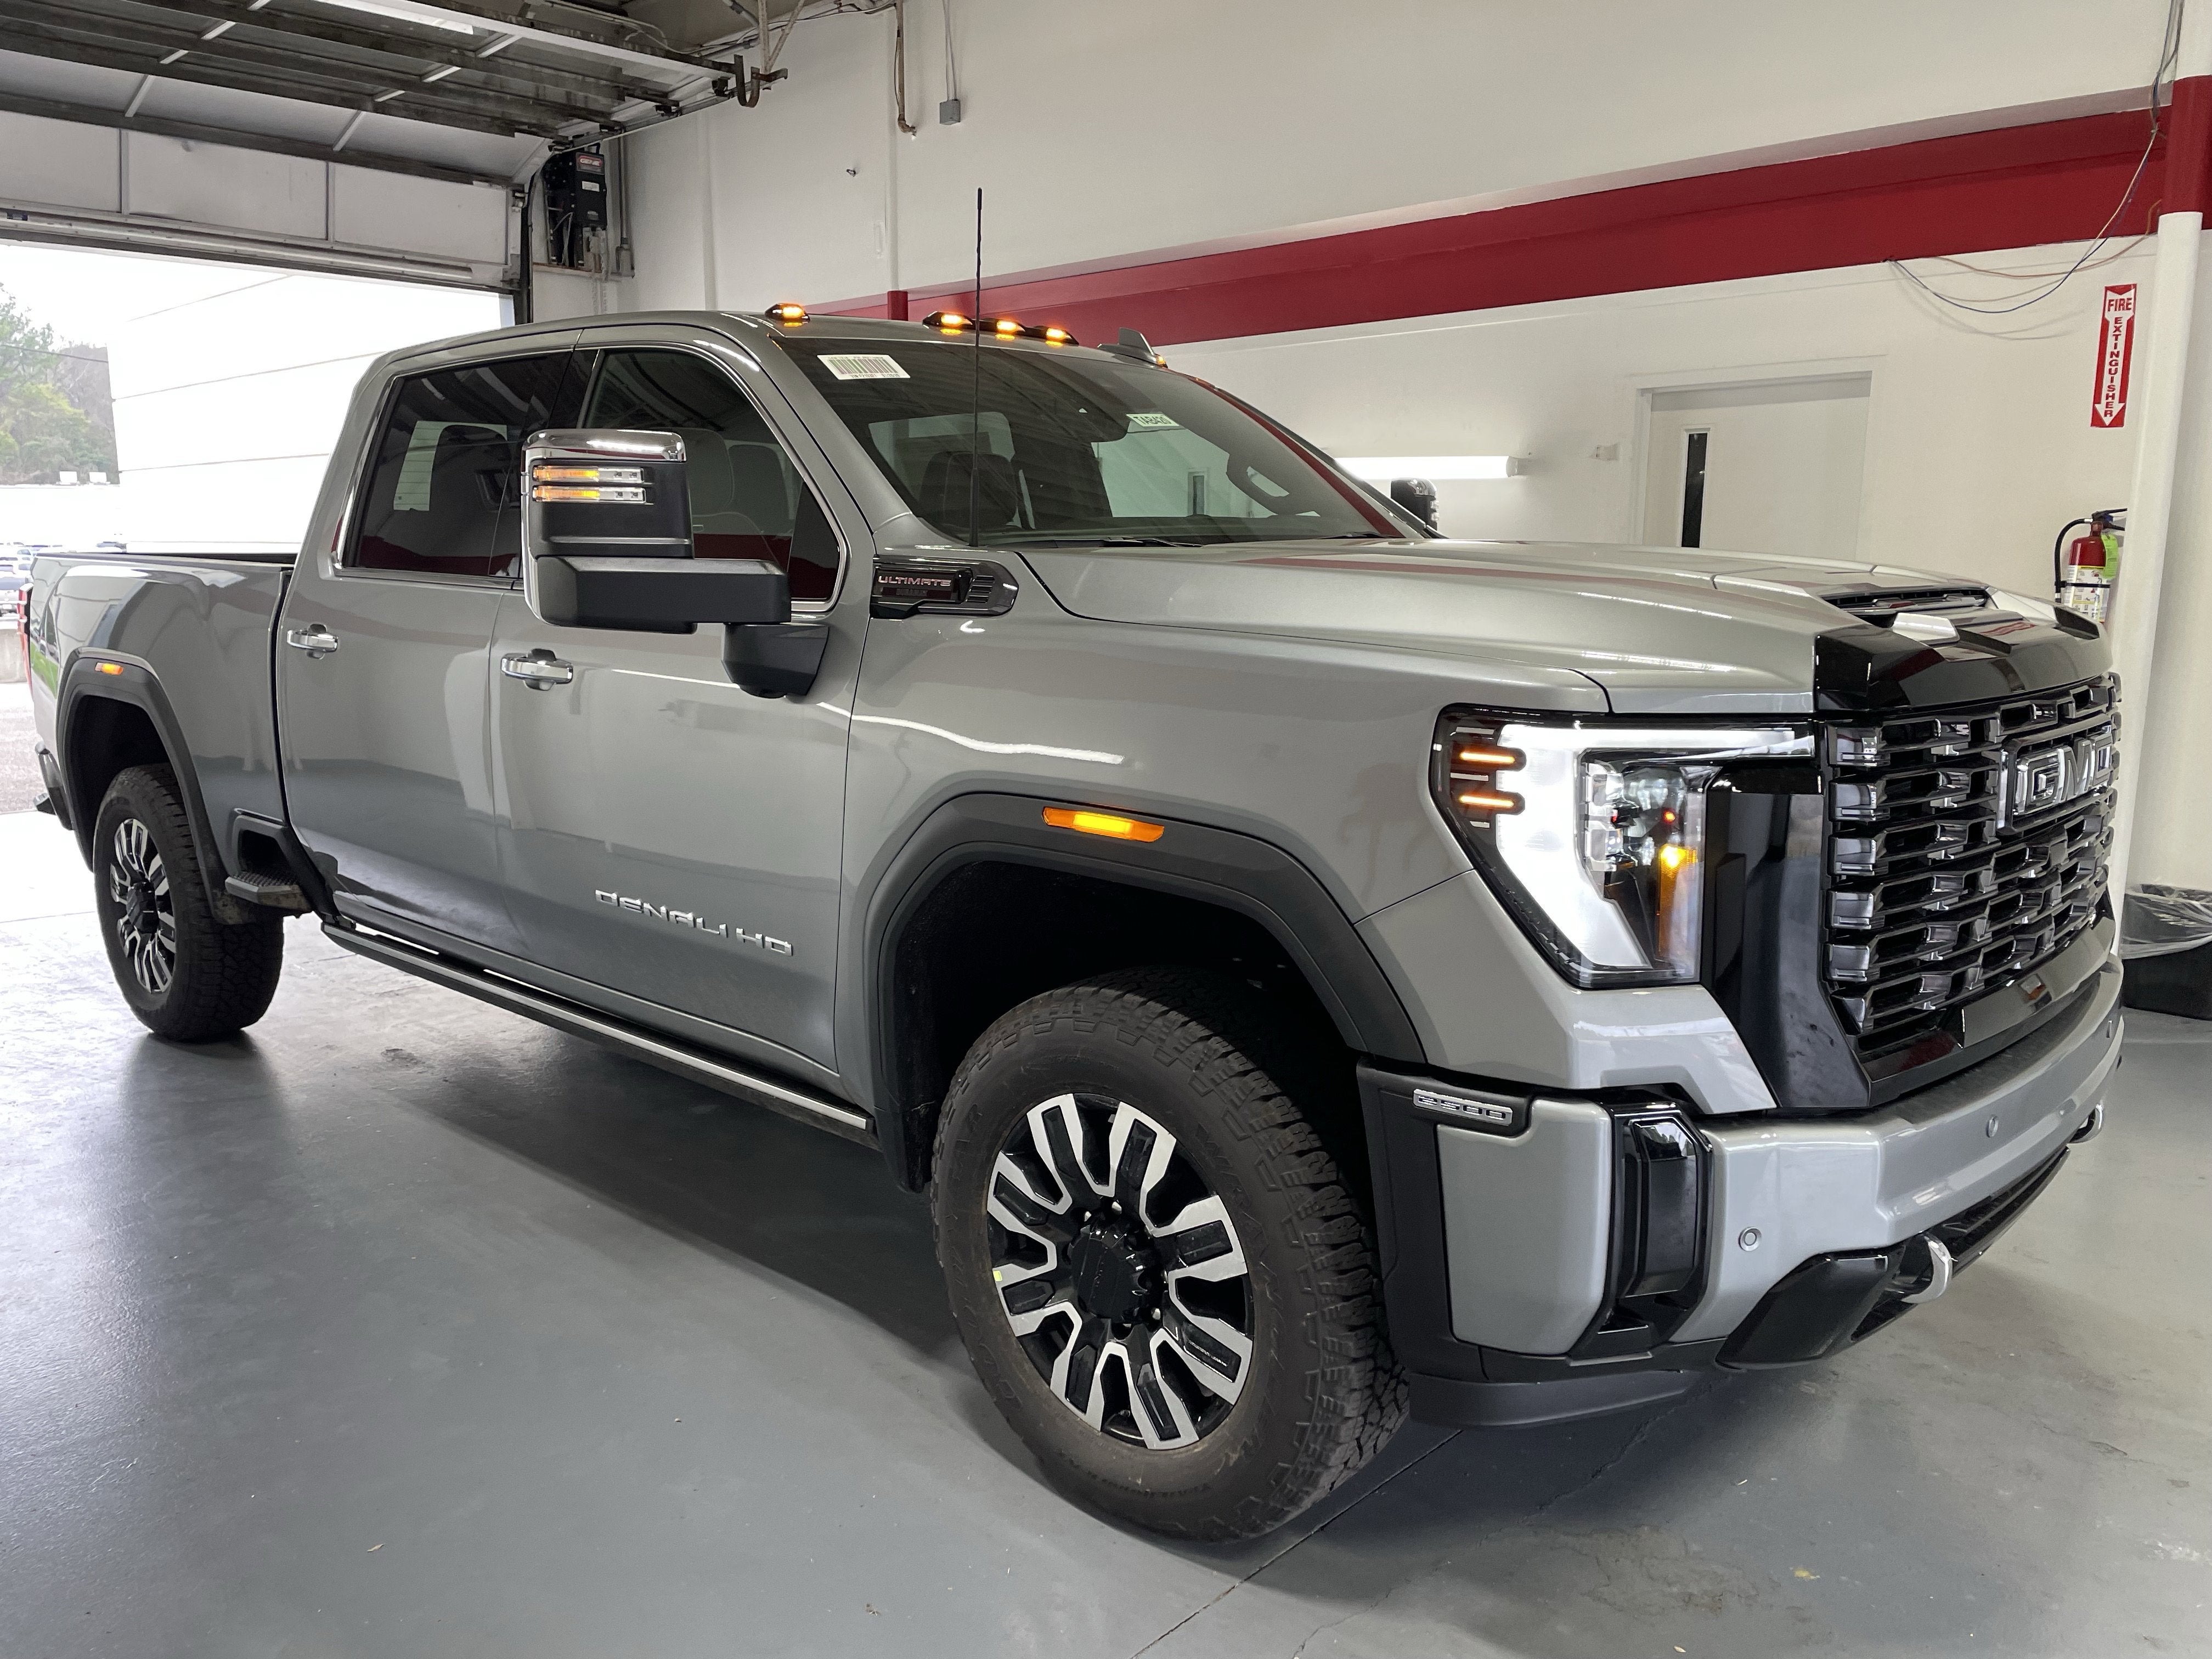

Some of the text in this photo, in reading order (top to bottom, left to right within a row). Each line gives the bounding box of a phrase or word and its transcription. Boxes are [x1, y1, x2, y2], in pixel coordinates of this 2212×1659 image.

[2107, 297, 2133, 312] FIRE
[2104, 317, 2123, 417] EXTINGUISHER
[878, 575, 952, 586] ULTIMATE
[2013, 732, 2112, 815] GMC
[595, 889, 794, 957] DENALI HD
[1418, 1095, 1506, 1121] 2500
